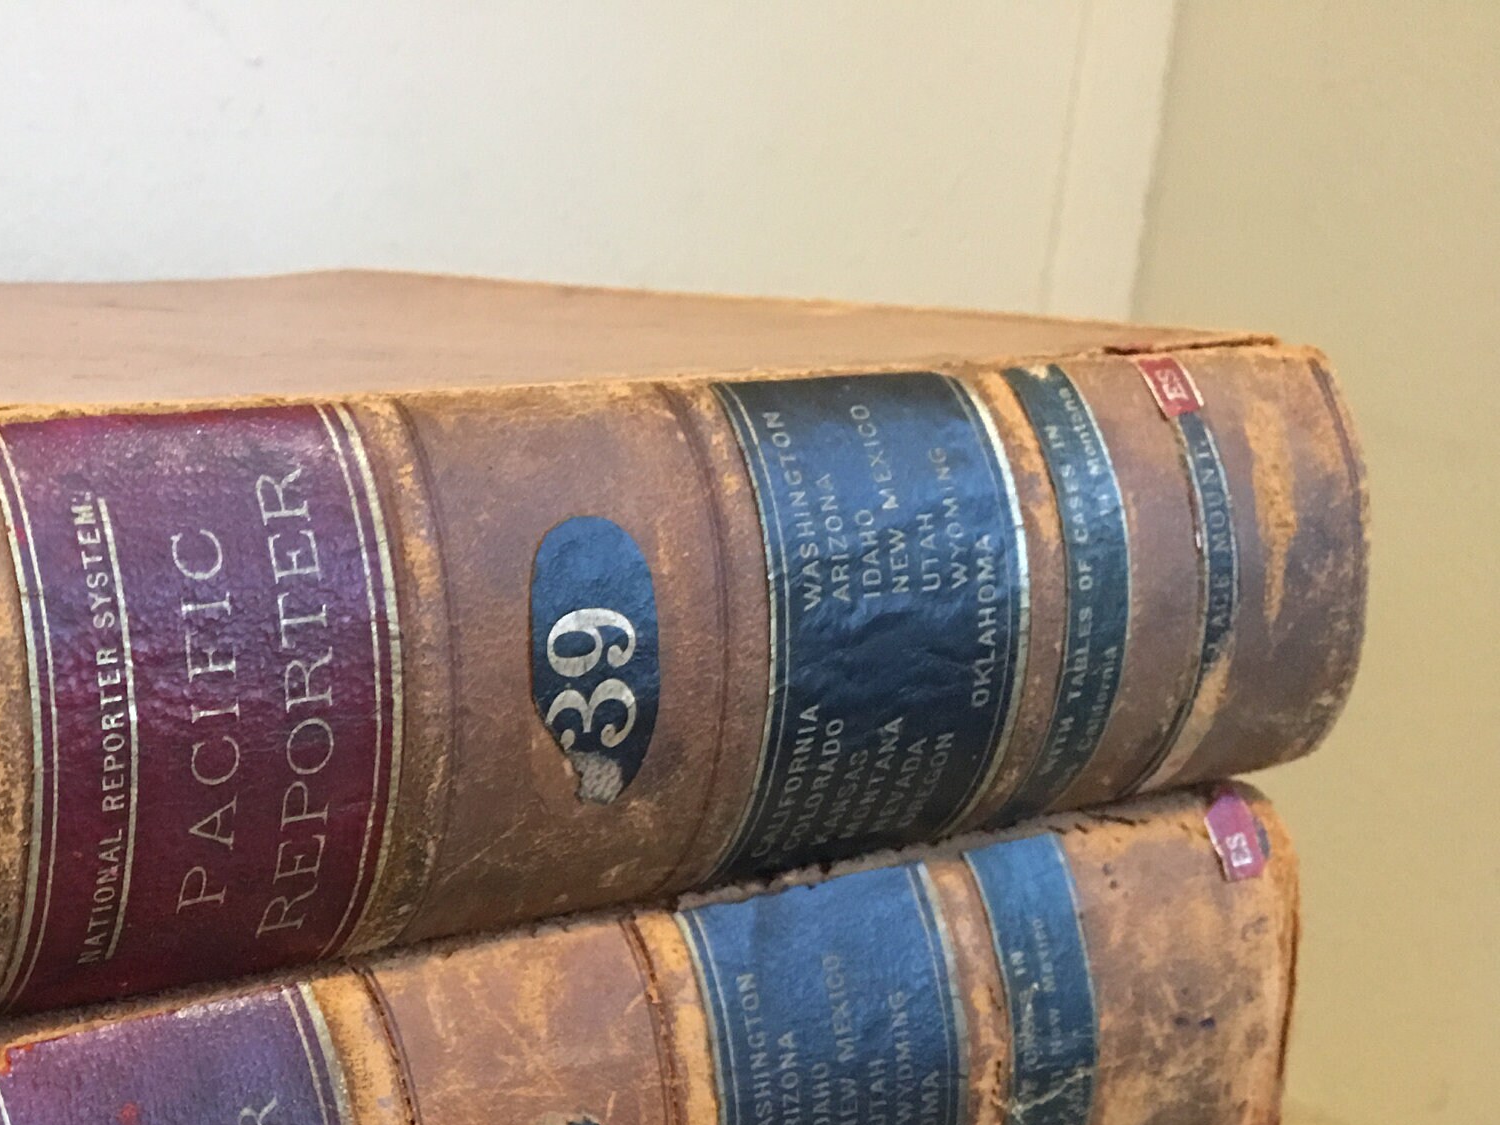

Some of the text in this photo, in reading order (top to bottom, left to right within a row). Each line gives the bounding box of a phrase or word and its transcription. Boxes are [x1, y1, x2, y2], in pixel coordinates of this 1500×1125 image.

[1044, 424, 1064, 451] IN
[1058, 386, 1099, 477] Montana
[1155, 367, 1189, 403] ES
[761, 408, 823, 612] WASHINGTON
[815, 472, 852, 603] ARIZONA
[849, 403, 910, 594] NEW MEXICO
[855, 508, 882, 598] IDAHO
[915, 511, 942, 593] UTAH
[927, 446, 971, 589] WYOMING
[1060, 462, 1090, 544] CASES
[970, 533, 998, 707] OKLAHOMA
[1076, 558, 1095, 590] OF
[253, 464, 334, 939] REPORTER
[545, 608, 637, 751] 39
[1066, 606, 1094, 701] TABLES
[94, 647, 127, 811] REPORTER
[169, 528, 242, 914] PACIFIC
[838, 715, 904, 839] MONTANA
[898, 731, 955, 827] OREGON
[1038, 717, 1076, 777] WITH
[750, 703, 821, 858] CALIFORNIA
[781, 718, 845, 852] COLORADO
[812, 748, 870, 845] KANSAS
[869, 736, 929, 832] NEVADA
[75, 829, 124, 965] NATIONAL
[1224, 833, 1253, 867] ES
[822, 953, 856, 1062] MEXICO
[887, 990, 915, 1125] WYOMING
